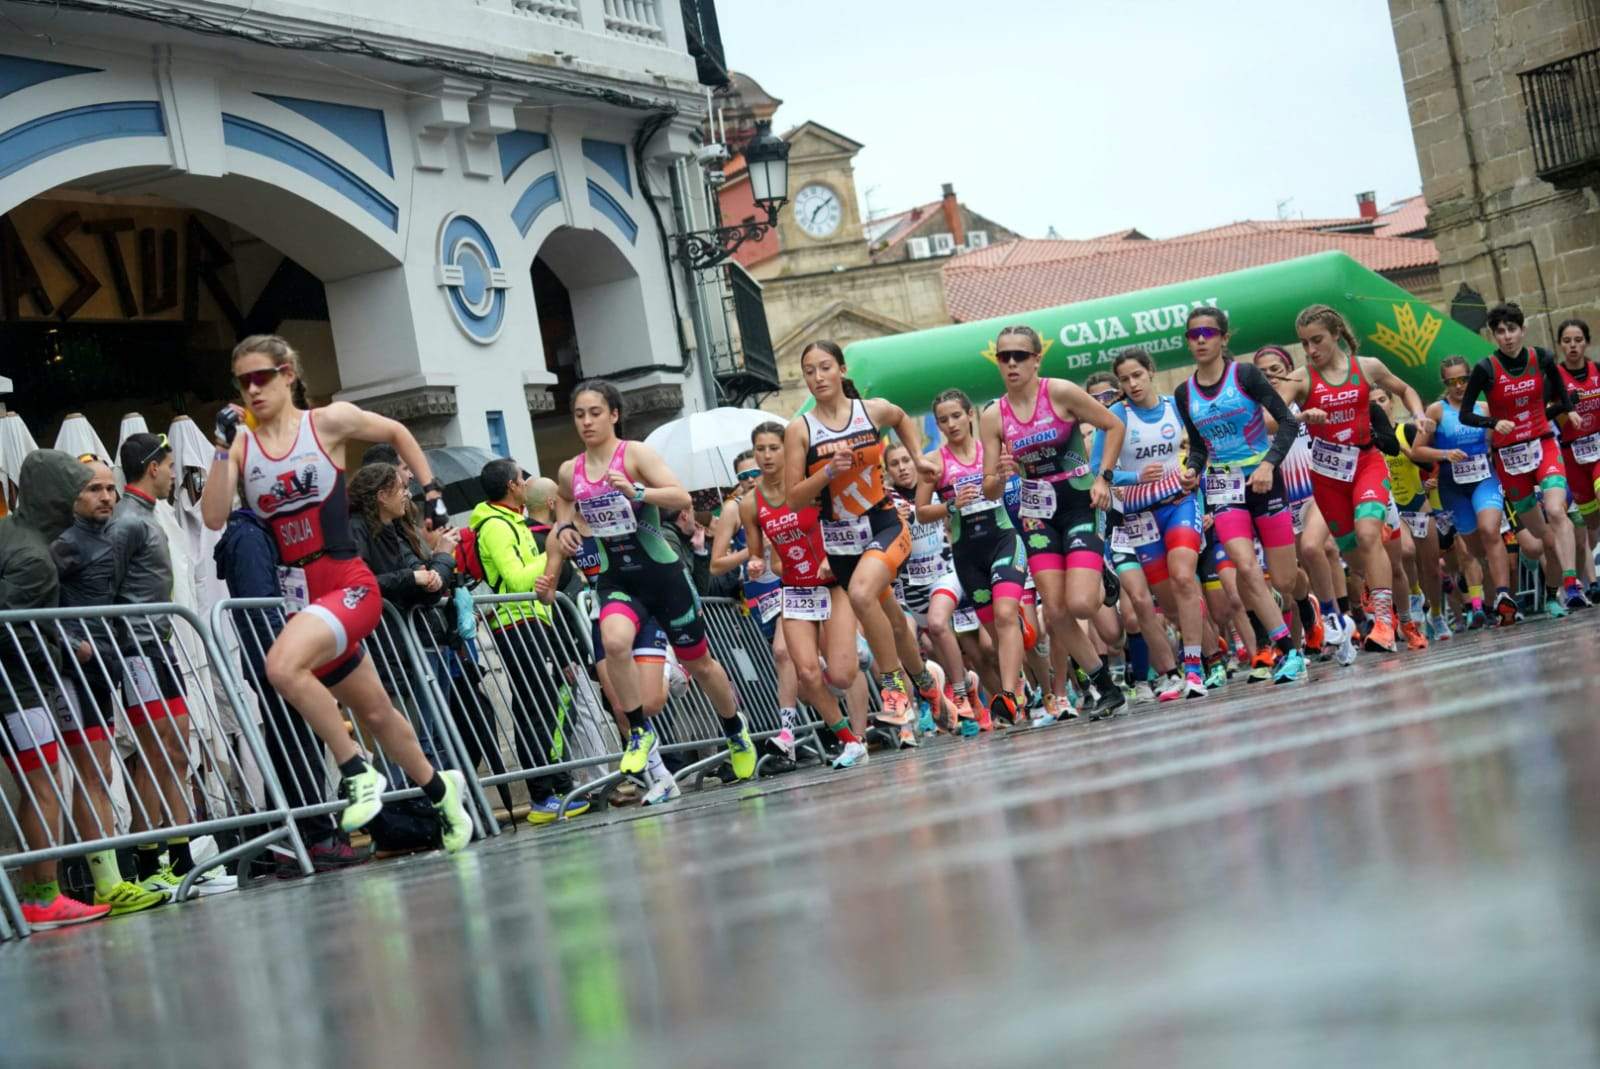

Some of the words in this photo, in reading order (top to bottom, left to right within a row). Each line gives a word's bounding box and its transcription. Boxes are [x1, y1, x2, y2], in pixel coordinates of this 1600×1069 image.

[1060, 316, 1130, 347] CAJA
[1066, 353, 1092, 370] DE
[1096, 336, 1183, 364] ASRIAS
[1504, 379, 1536, 392] FLOR
[1320, 389, 1359, 404] FLOR
[1328, 408, 1356, 424] ARILLO
[1013, 428, 1057, 449] SALTOKI
[1135, 442, 1173, 459] ZAFRA
[1312, 449, 1340, 467] 2143
[584, 510, 615, 524] 2102
[766, 512, 798, 529] FLOR
[281, 518, 313, 546] SICILIA
[825, 531, 854, 541] 2316
[785, 599, 815, 609] 2123
